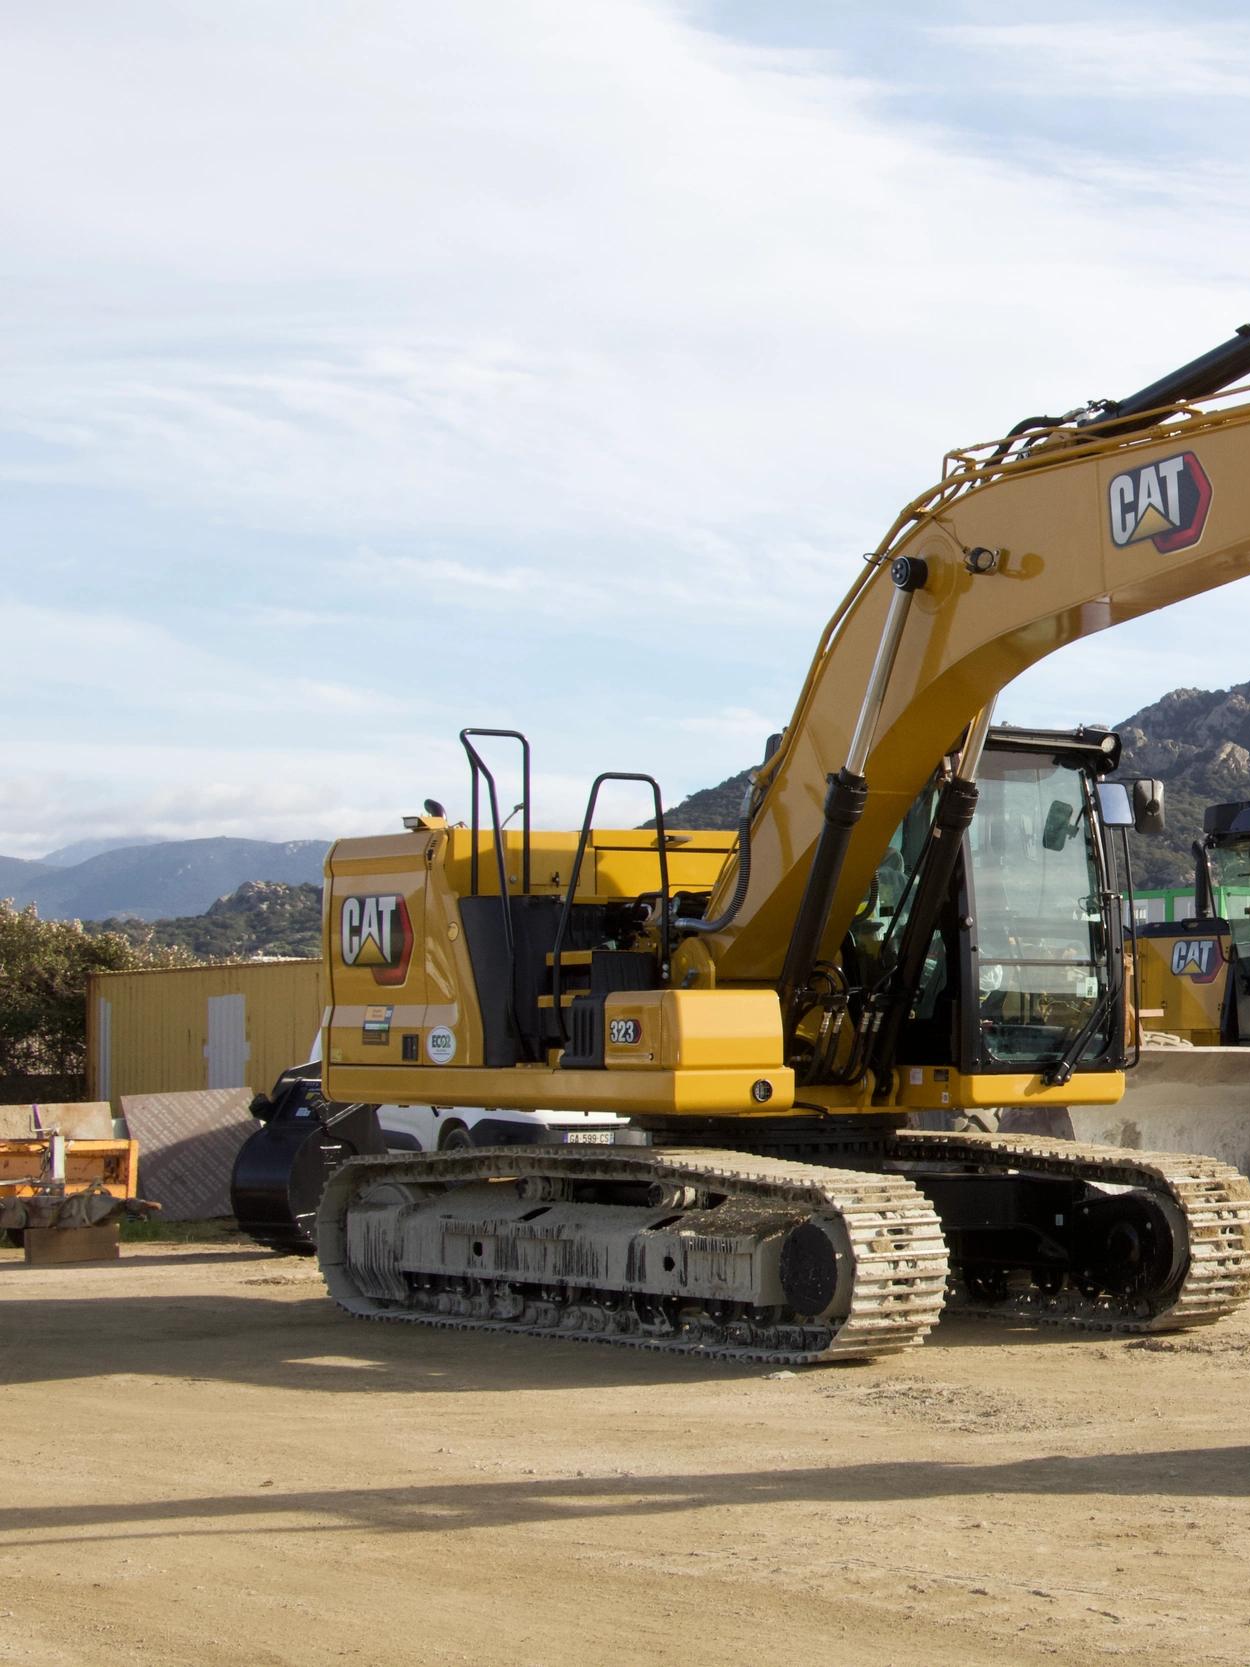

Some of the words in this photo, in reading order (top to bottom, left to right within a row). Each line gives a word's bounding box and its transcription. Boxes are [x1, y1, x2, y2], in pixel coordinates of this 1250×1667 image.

[1110, 456, 1184, 545] CAT
[342, 896, 397, 965] CAT
[1171, 941, 1213, 974] CAT
[610, 1020, 634, 1042] 323
